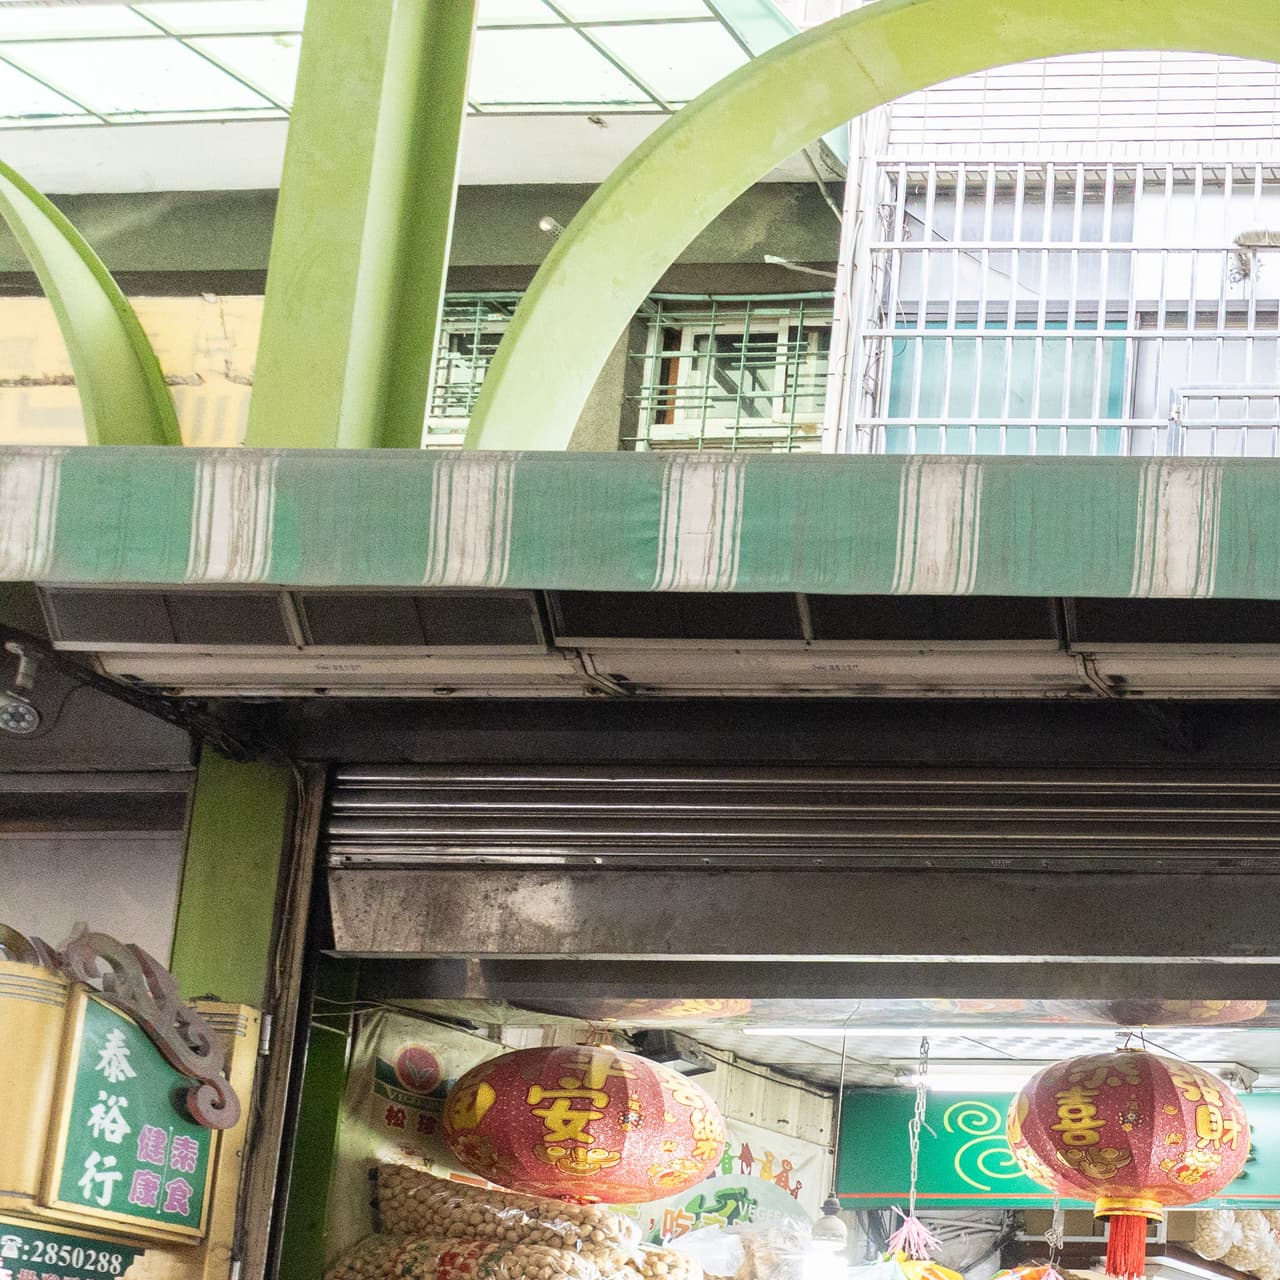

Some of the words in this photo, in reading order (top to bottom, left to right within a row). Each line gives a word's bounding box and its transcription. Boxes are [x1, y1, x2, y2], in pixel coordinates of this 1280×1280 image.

[78, 1028, 137, 1206] 泰裕行
[128, 1124, 167, 1208] 健康
[163, 1135, 199, 1216] 素食
